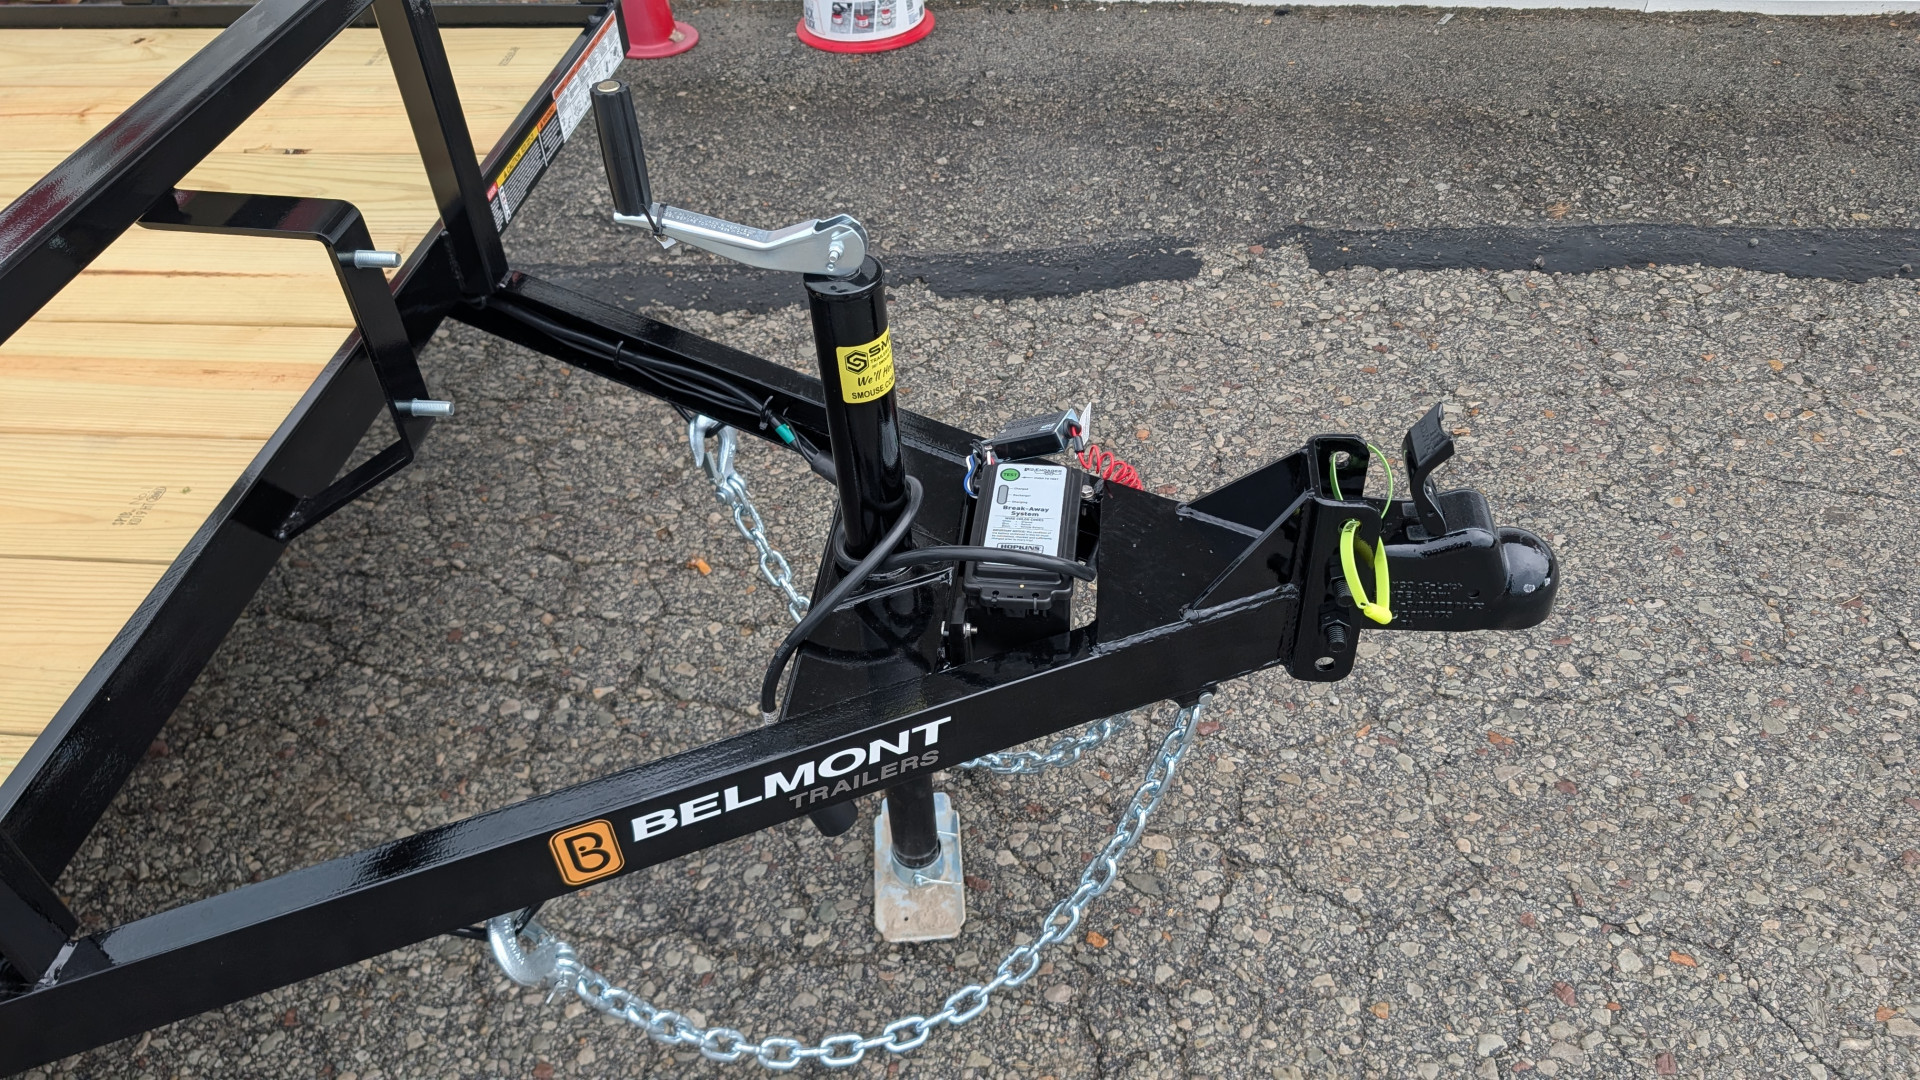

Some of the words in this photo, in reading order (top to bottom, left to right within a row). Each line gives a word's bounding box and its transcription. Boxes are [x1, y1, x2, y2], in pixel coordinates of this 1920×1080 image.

[868, 334, 891, 357] SM
[1002, 505, 1050, 513] Break-Away
[631, 716, 952, 843] BELMONT
[787, 749, 940, 810] TRAILERS
